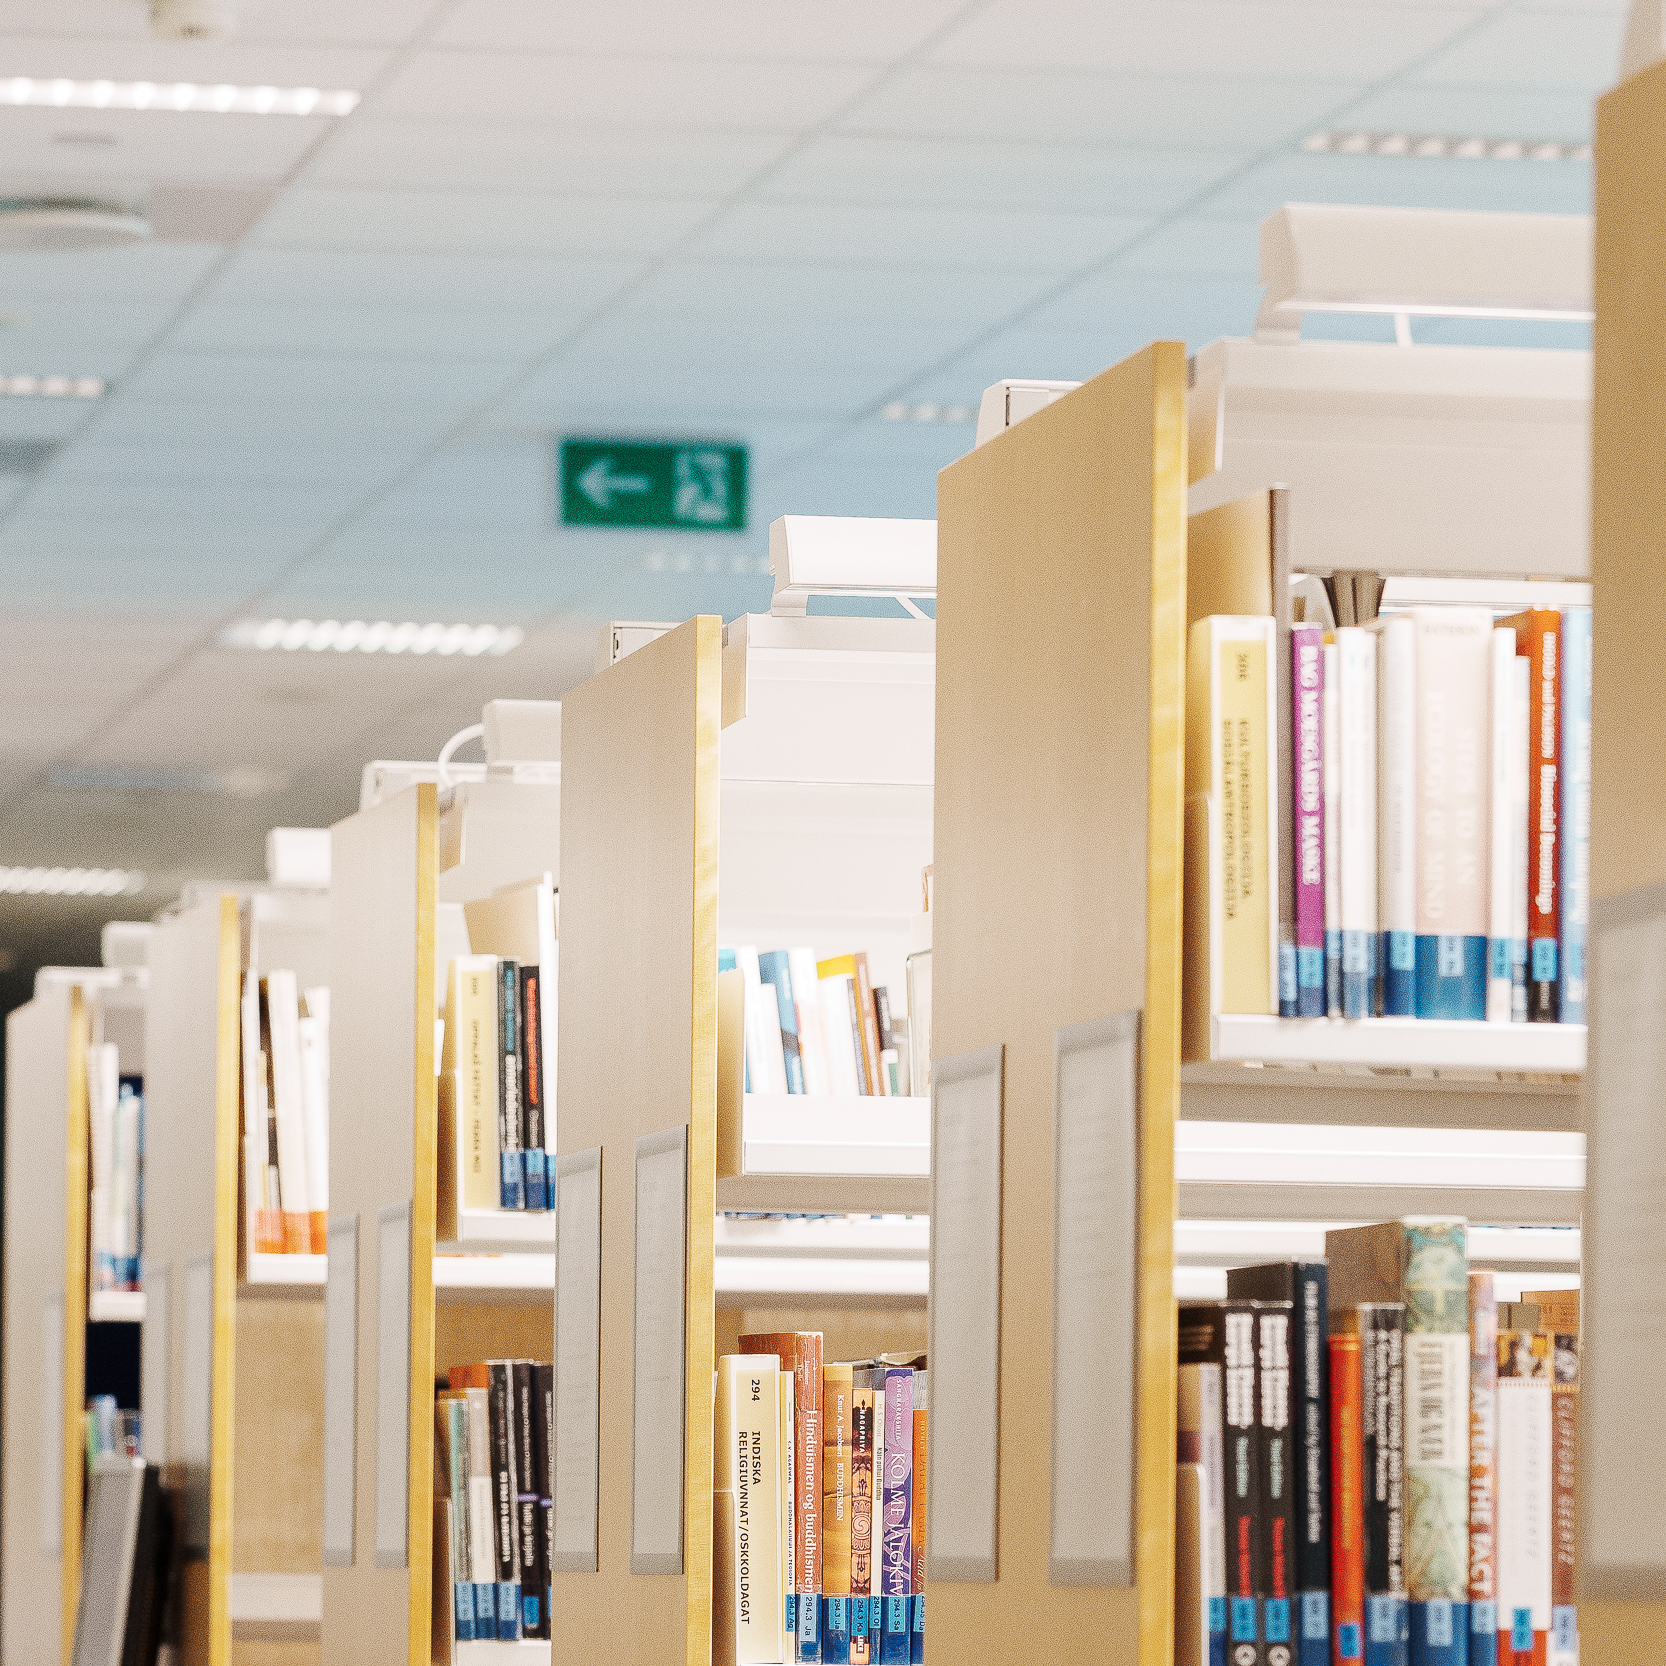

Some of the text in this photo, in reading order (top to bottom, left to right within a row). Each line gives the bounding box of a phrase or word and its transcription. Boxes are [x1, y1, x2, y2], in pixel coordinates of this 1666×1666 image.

[751, 1379, 761, 1402] 294
[837, 1414, 844, 1423] A.
[752, 1431, 761, 1486] INDISKA
[890, 1453, 905, 1516] KOLME
[1554, 1394, 1574, 1566] CLIFFORD GEERTZ
[803, 1410, 818, 1592] Hinduismen og buddhismen
[738, 1431, 751, 1625] RELIGIUVNNAT/OSKKOLDAGAT
[804, 1597, 812, 1636] 294.3 Ja
[834, 1620, 841, 1630] Ja
[857, 1622, 864, 1632] Ka
[894, 1620, 901, 1631] Sa
